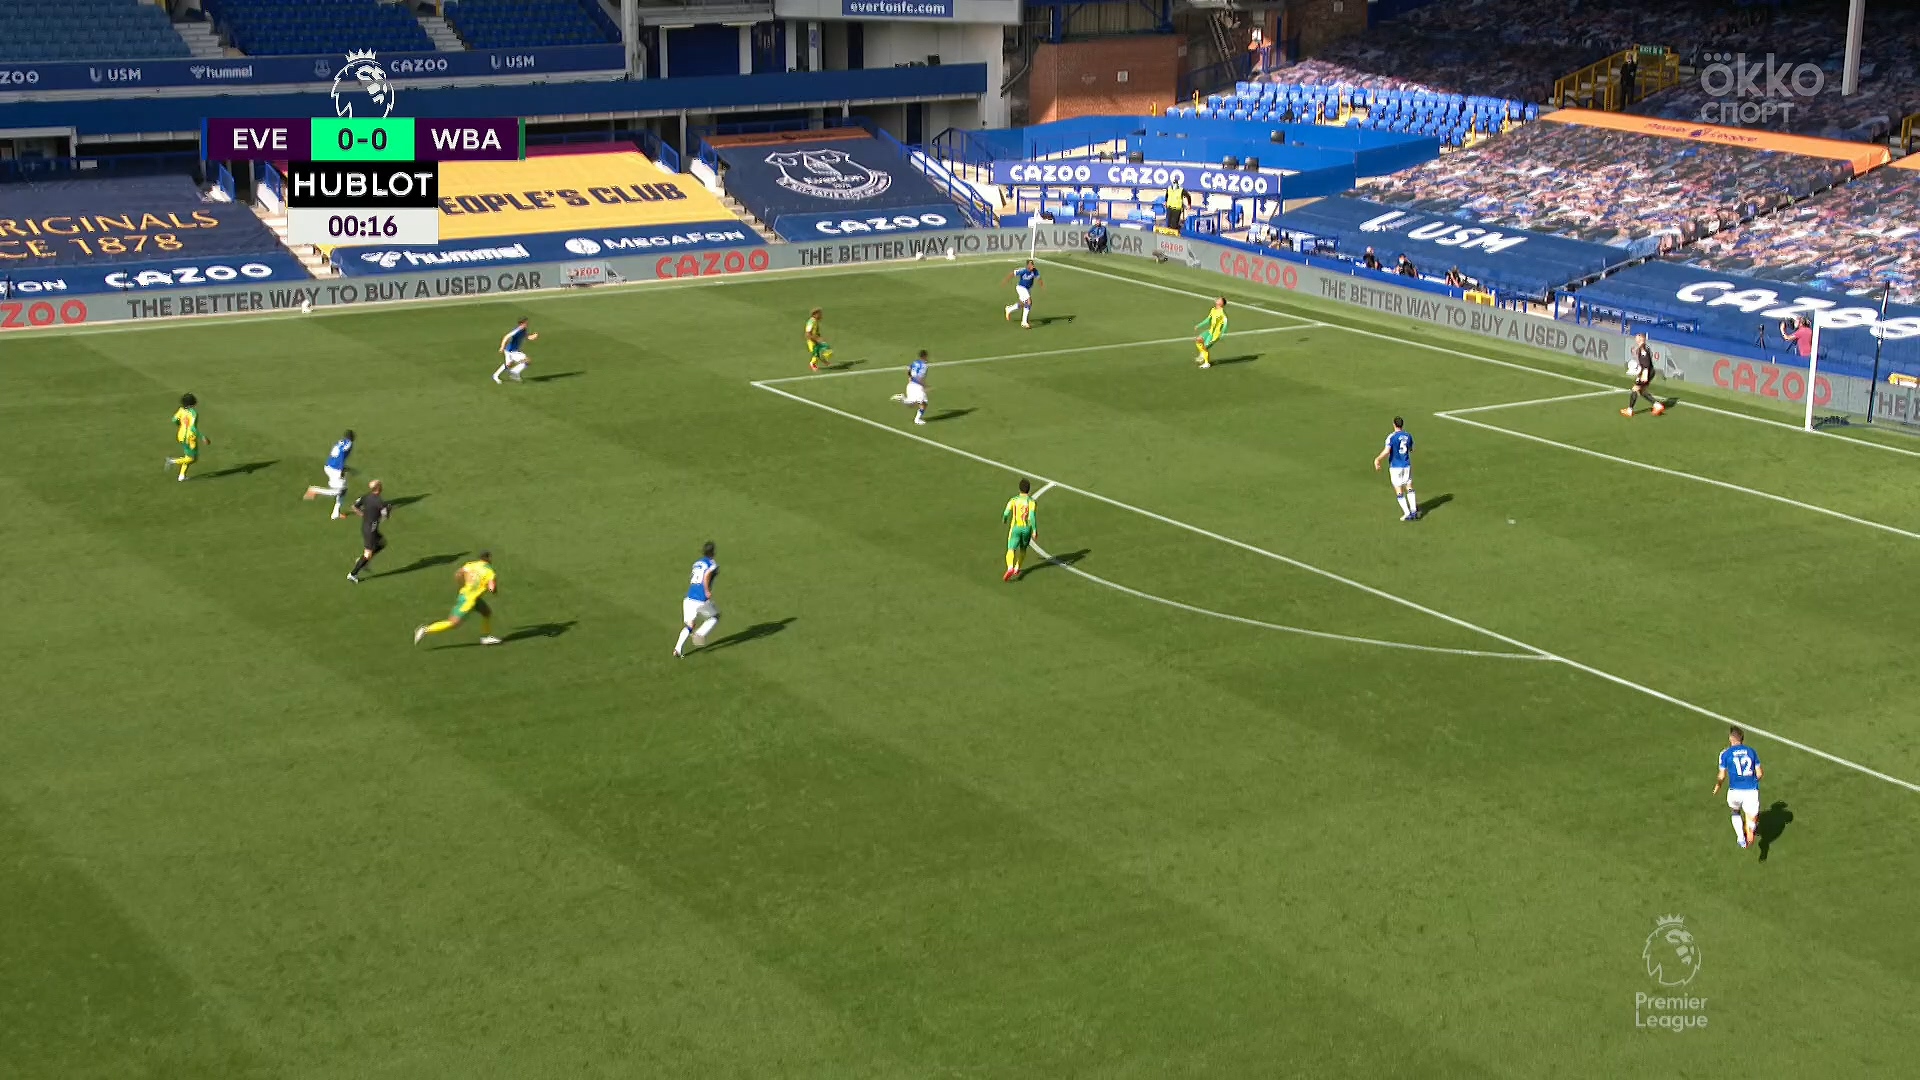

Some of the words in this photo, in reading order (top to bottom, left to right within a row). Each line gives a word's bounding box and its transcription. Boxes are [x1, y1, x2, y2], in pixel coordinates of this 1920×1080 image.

[206, 65, 253, 78] hummel
[390, 59, 448, 72] CAZOO
[505, 55, 535, 68] USM
[107, 67, 141, 81] USM
[1009, 164, 1091, 182] CAZOO
[1107, 165, 1185, 186] CAZOO
[1199, 171, 1268, 194] CAZOO
[587, 182, 687, 205] CLUB
[815, 212, 948, 235] CAZOO
[68, 232, 184, 256] 1878
[798, 248, 834, 267] THE
[838, 240, 906, 264] BETTER
[908, 236, 949, 257] WAY
[953, 234, 981, 254] TO
[986, 233, 1028, 253] BUY
[1034, 230, 1048, 249] A
[1109, 233, 1144, 254] CAR
[1407, 221, 1529, 254] USM
[401, 243, 531, 265] hummel
[655, 248, 770, 280] CAZOO
[104, 263, 273, 290] CAZOO
[1219, 250, 1299, 290] CAZOO
[127, 297, 173, 319] THE
[179, 291, 264, 316] BETTER
[269, 286, 321, 310] WAY
[326, 284, 359, 306] TO
[364, 280, 408, 303] BUY
[414, 280, 431, 299] A
[436, 275, 492, 297] USED
[497, 271, 542, 292] CAR
[1319, 277, 1347, 300] THE
[1350, 284, 1403, 317] BETTER
[1406, 296, 1442, 322] WAY
[1445, 304, 1467, 328] TO
[1471, 311, 1505, 337] BUY
[1507, 320, 1520, 340] A
[1524, 323, 1568, 351] USED
[1572, 334, 1610, 361] CAR
[1733, 757, 1754, 777] 12
